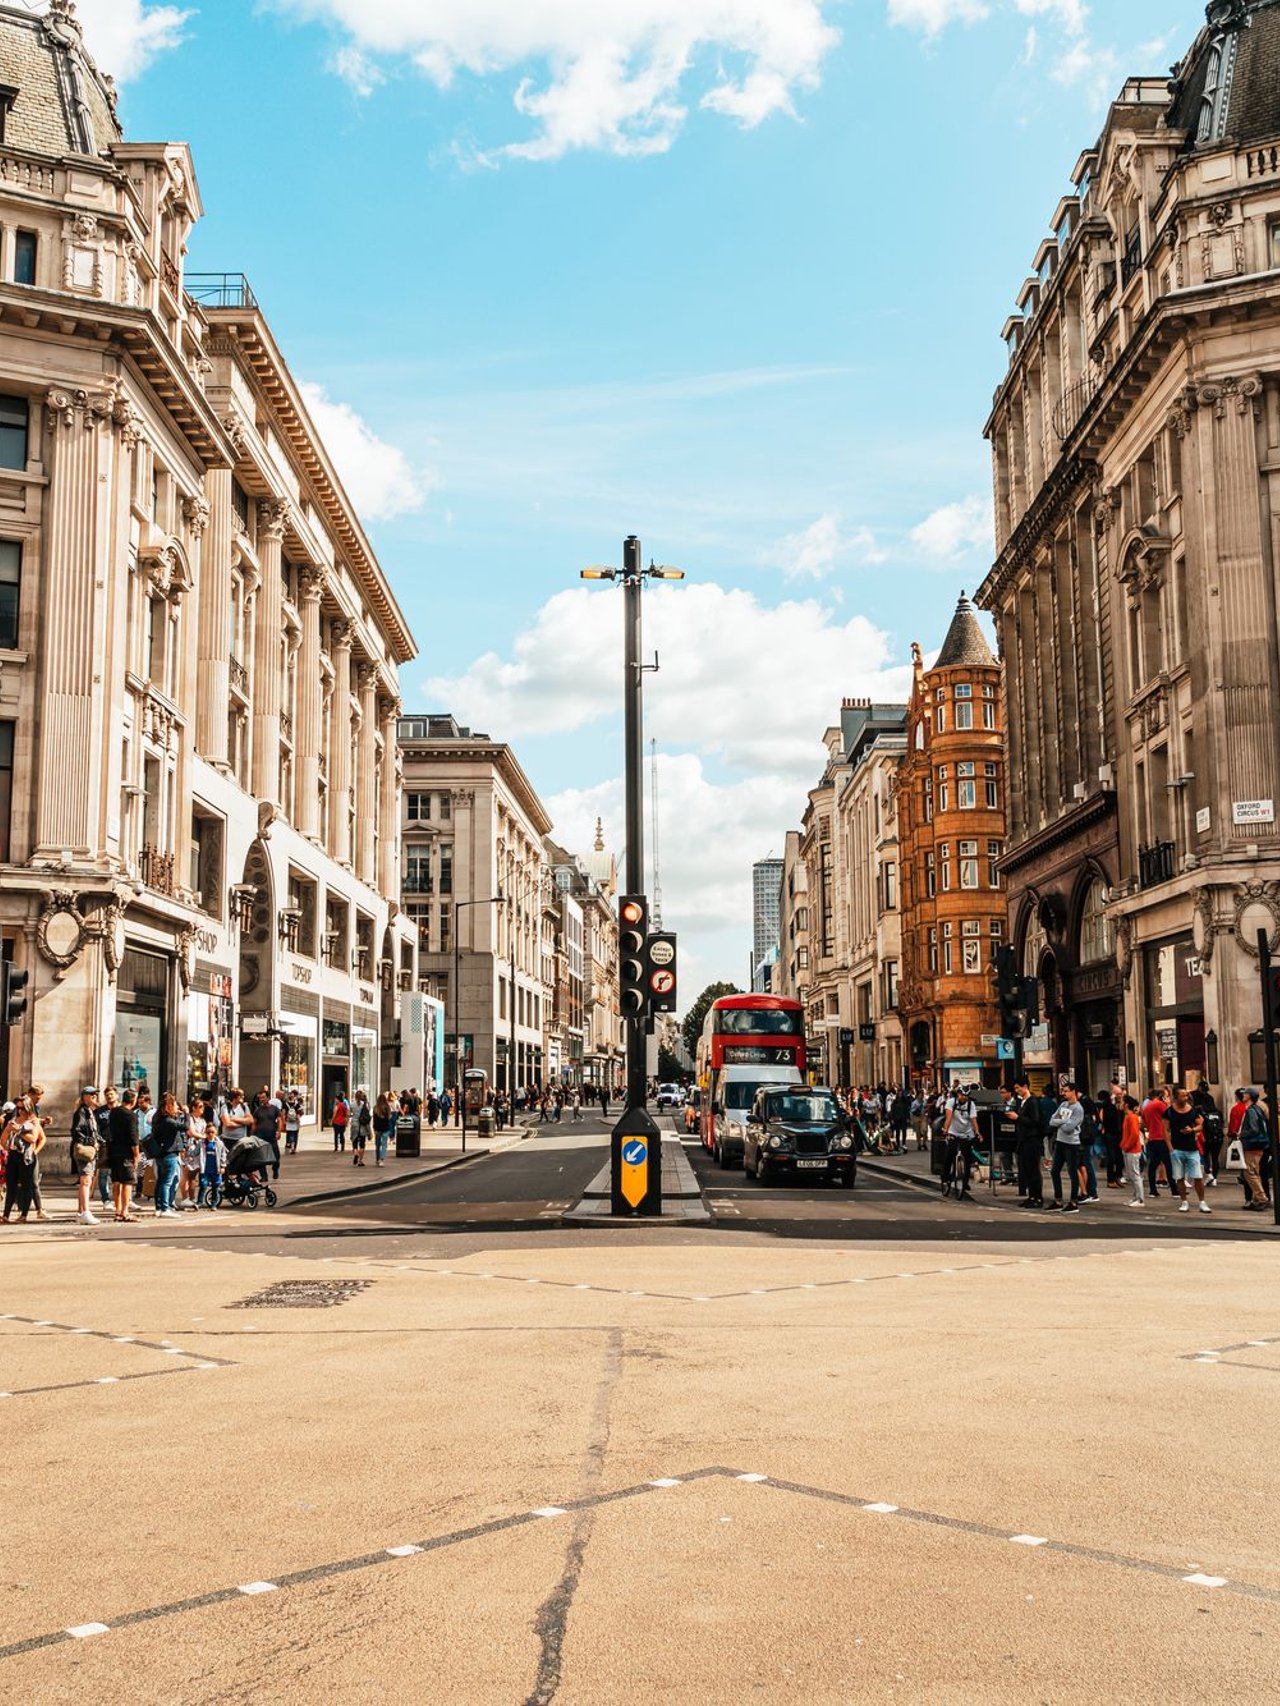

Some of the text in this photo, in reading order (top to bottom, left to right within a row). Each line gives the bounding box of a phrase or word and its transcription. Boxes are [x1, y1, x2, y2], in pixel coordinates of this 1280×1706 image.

[196, 930, 218, 954] SHOP
[291, 963, 312, 984] TOPSHOP
[1080, 971, 1109, 992] CIRCUS
[775, 1049, 791, 1061] 73
